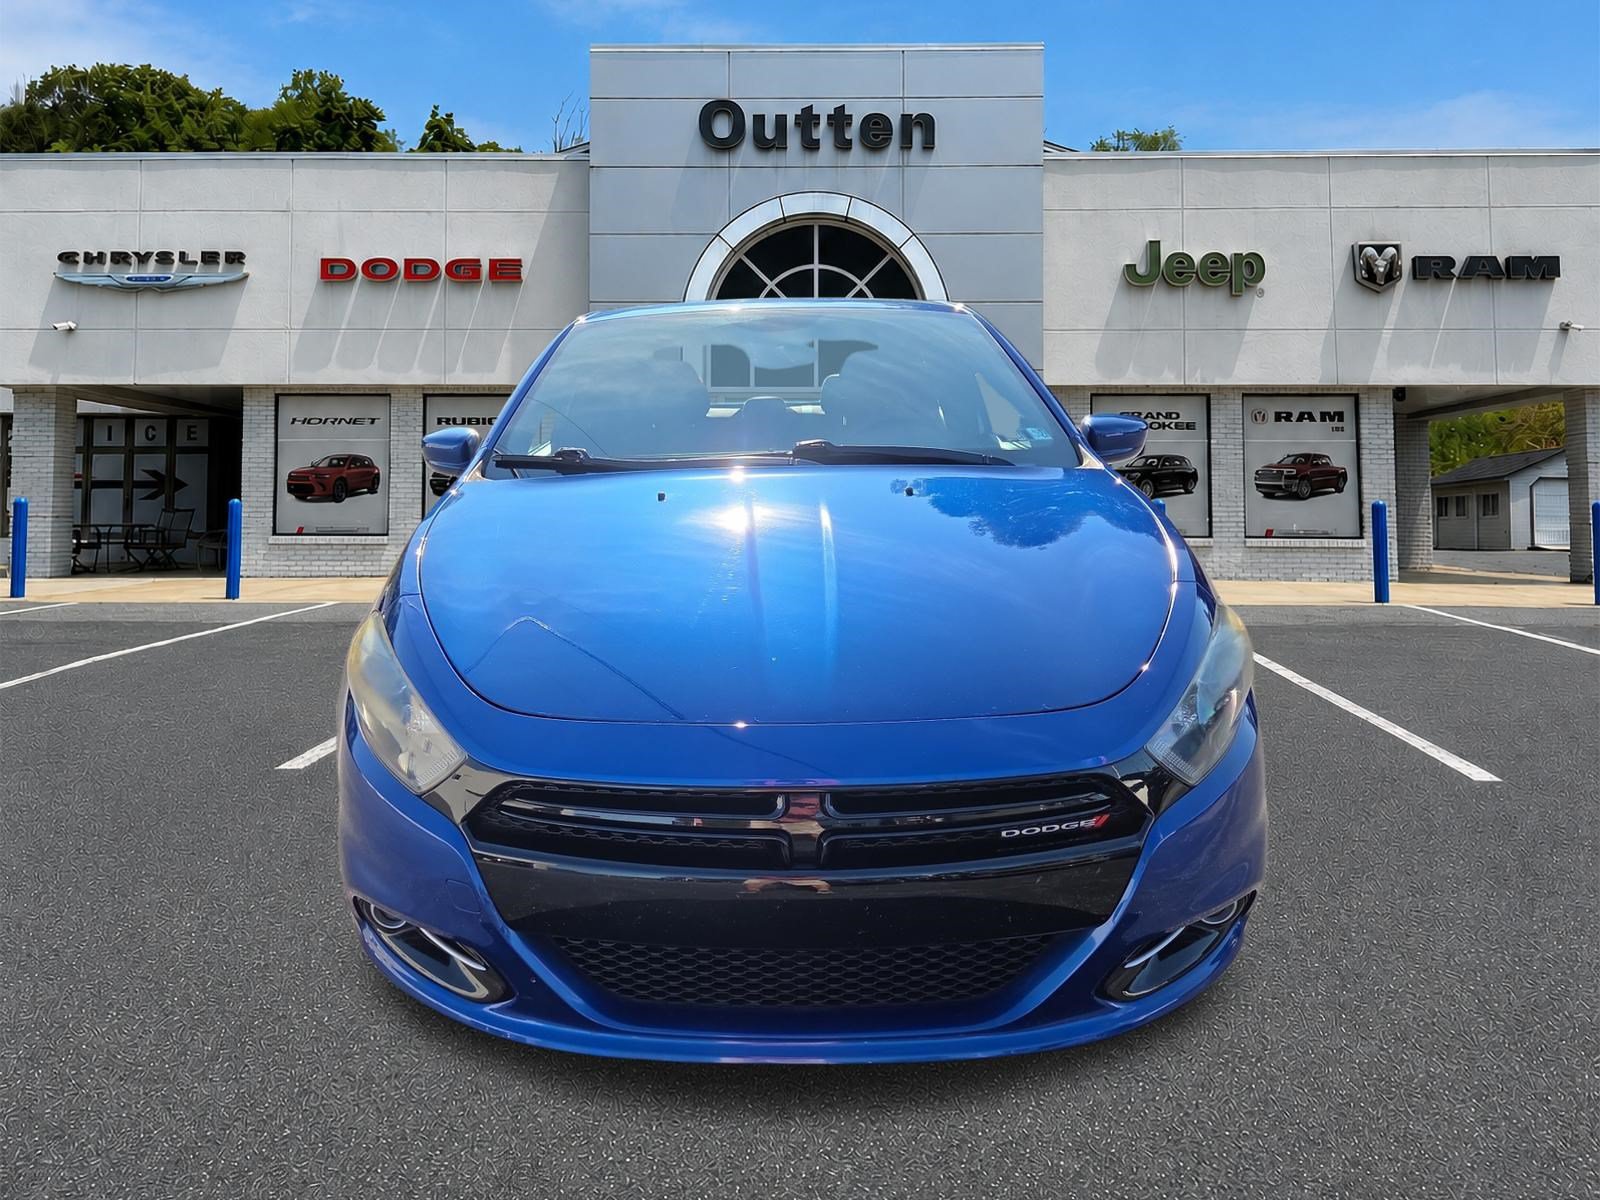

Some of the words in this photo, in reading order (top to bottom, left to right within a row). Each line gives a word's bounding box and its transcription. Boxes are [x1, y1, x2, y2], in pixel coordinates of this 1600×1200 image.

[699, 99, 936, 150] Outten
[57, 251, 246, 265] CHRYSLER
[320, 257, 523, 282] DODGE
[1123, 240, 1266, 296] Jeep
[1411, 255, 1561, 280] RAM
[290, 417, 381, 426] HORNET
[436, 417, 497, 426] RUBIC
[1274, 411, 1344, 422] RAM
[1149, 421, 1197, 431] OKEE
[1001, 819, 1096, 838] DODGE
